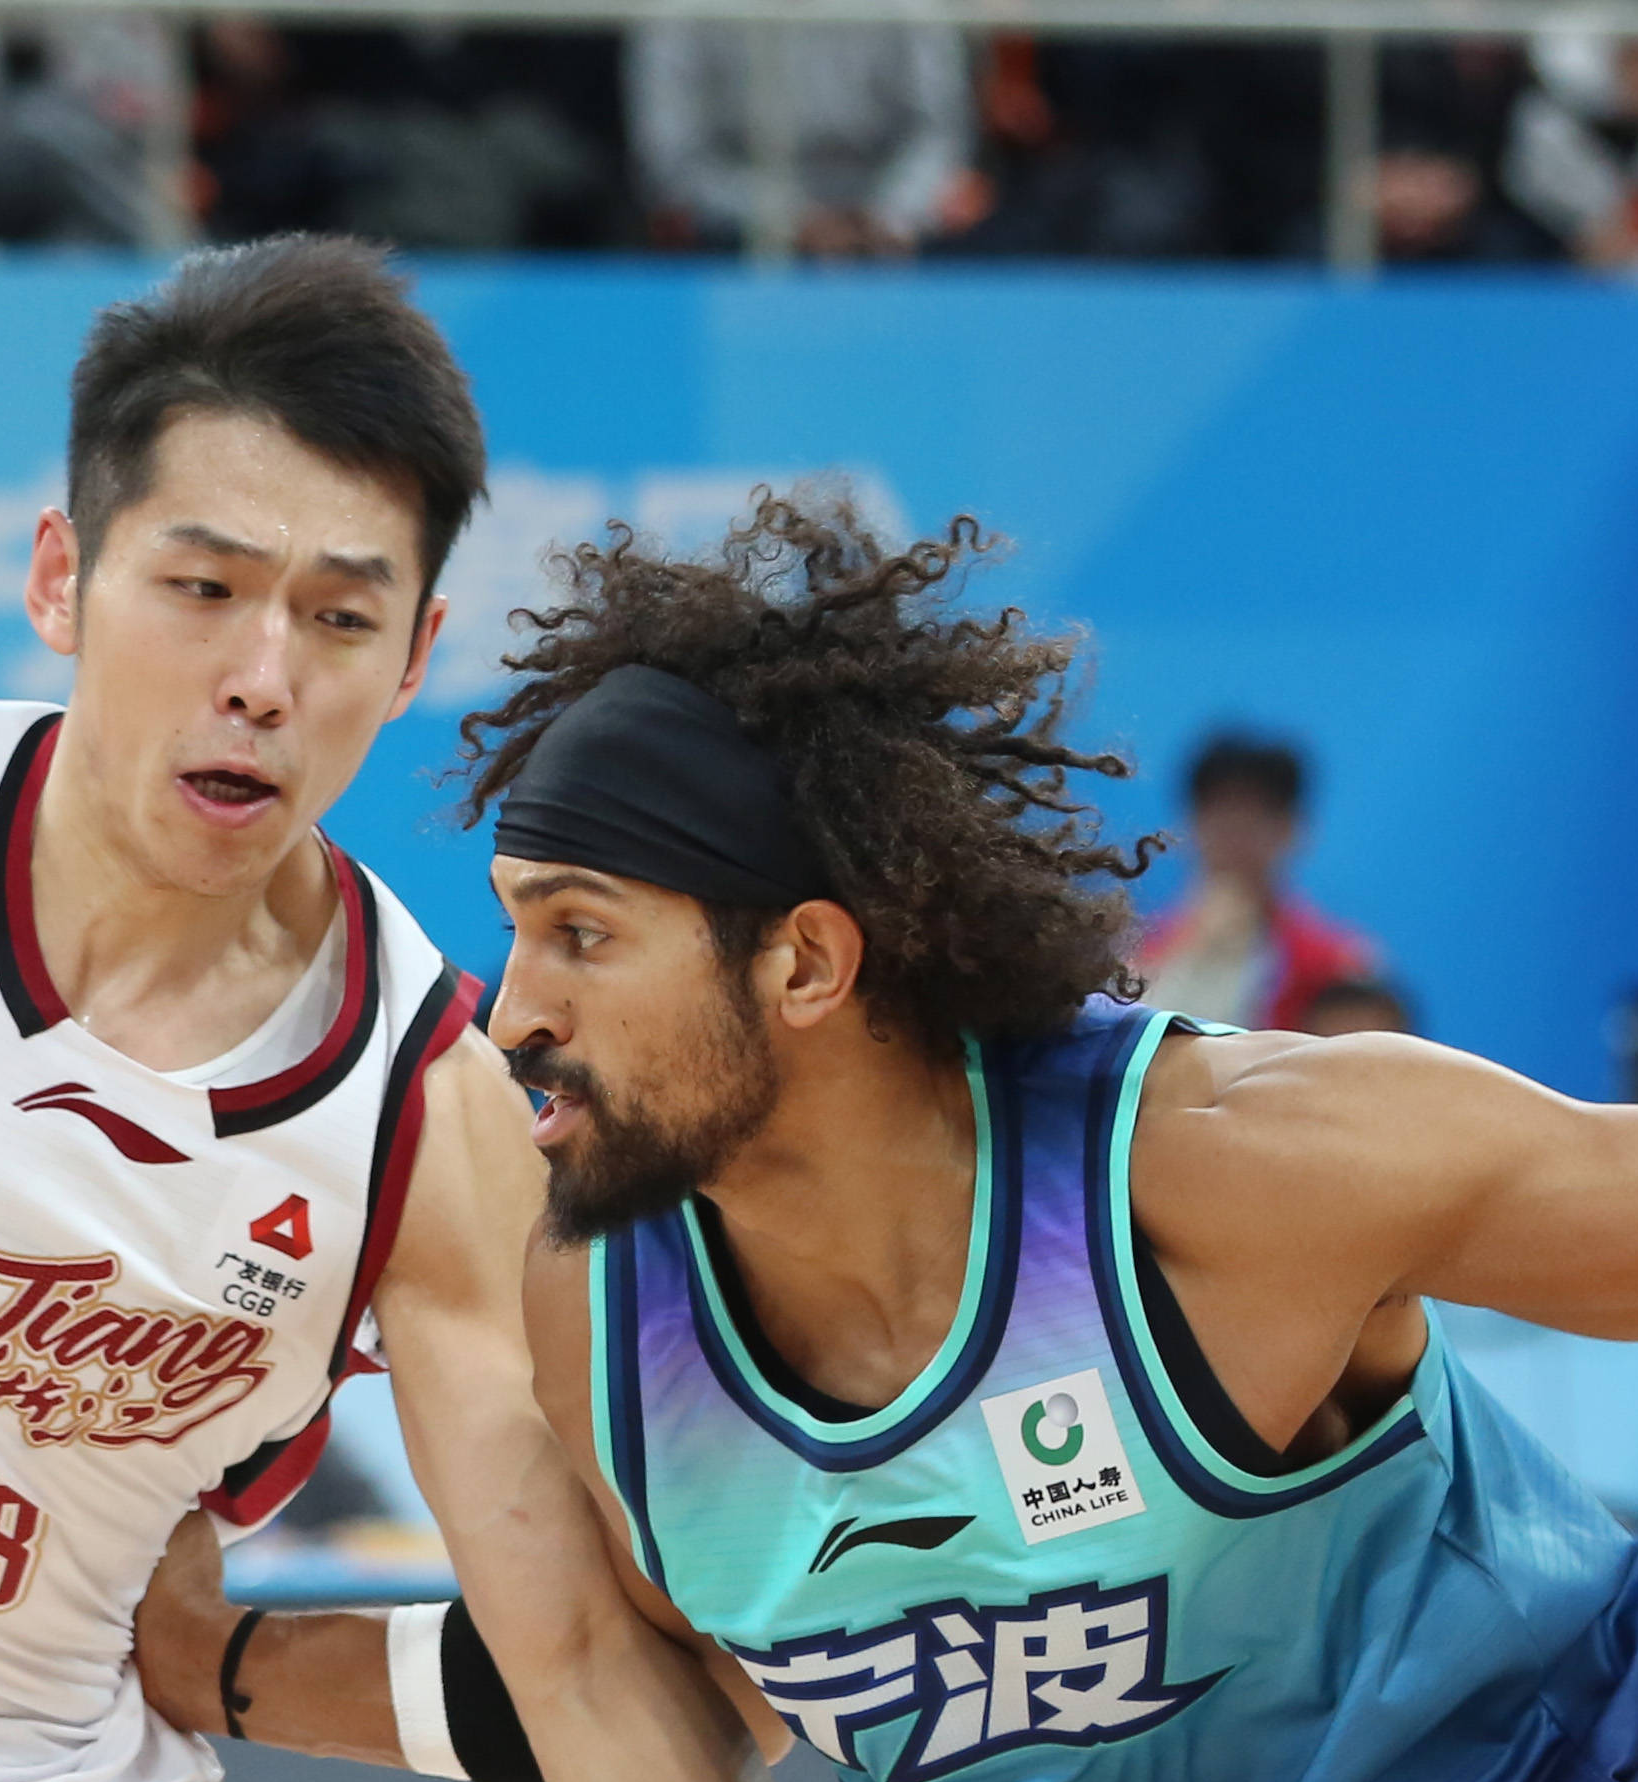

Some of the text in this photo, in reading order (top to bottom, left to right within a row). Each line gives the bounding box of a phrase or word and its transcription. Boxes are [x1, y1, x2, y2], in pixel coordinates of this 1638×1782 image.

[215, 1252, 307, 1300] 广发银行
[223, 1284, 276, 1317] CGB
[1022, 1466, 1122, 1510] 中国人寿
[1031, 1489, 1129, 1527] CHINA LIFE
[729, 1585, 1189, 1778] 宁波
